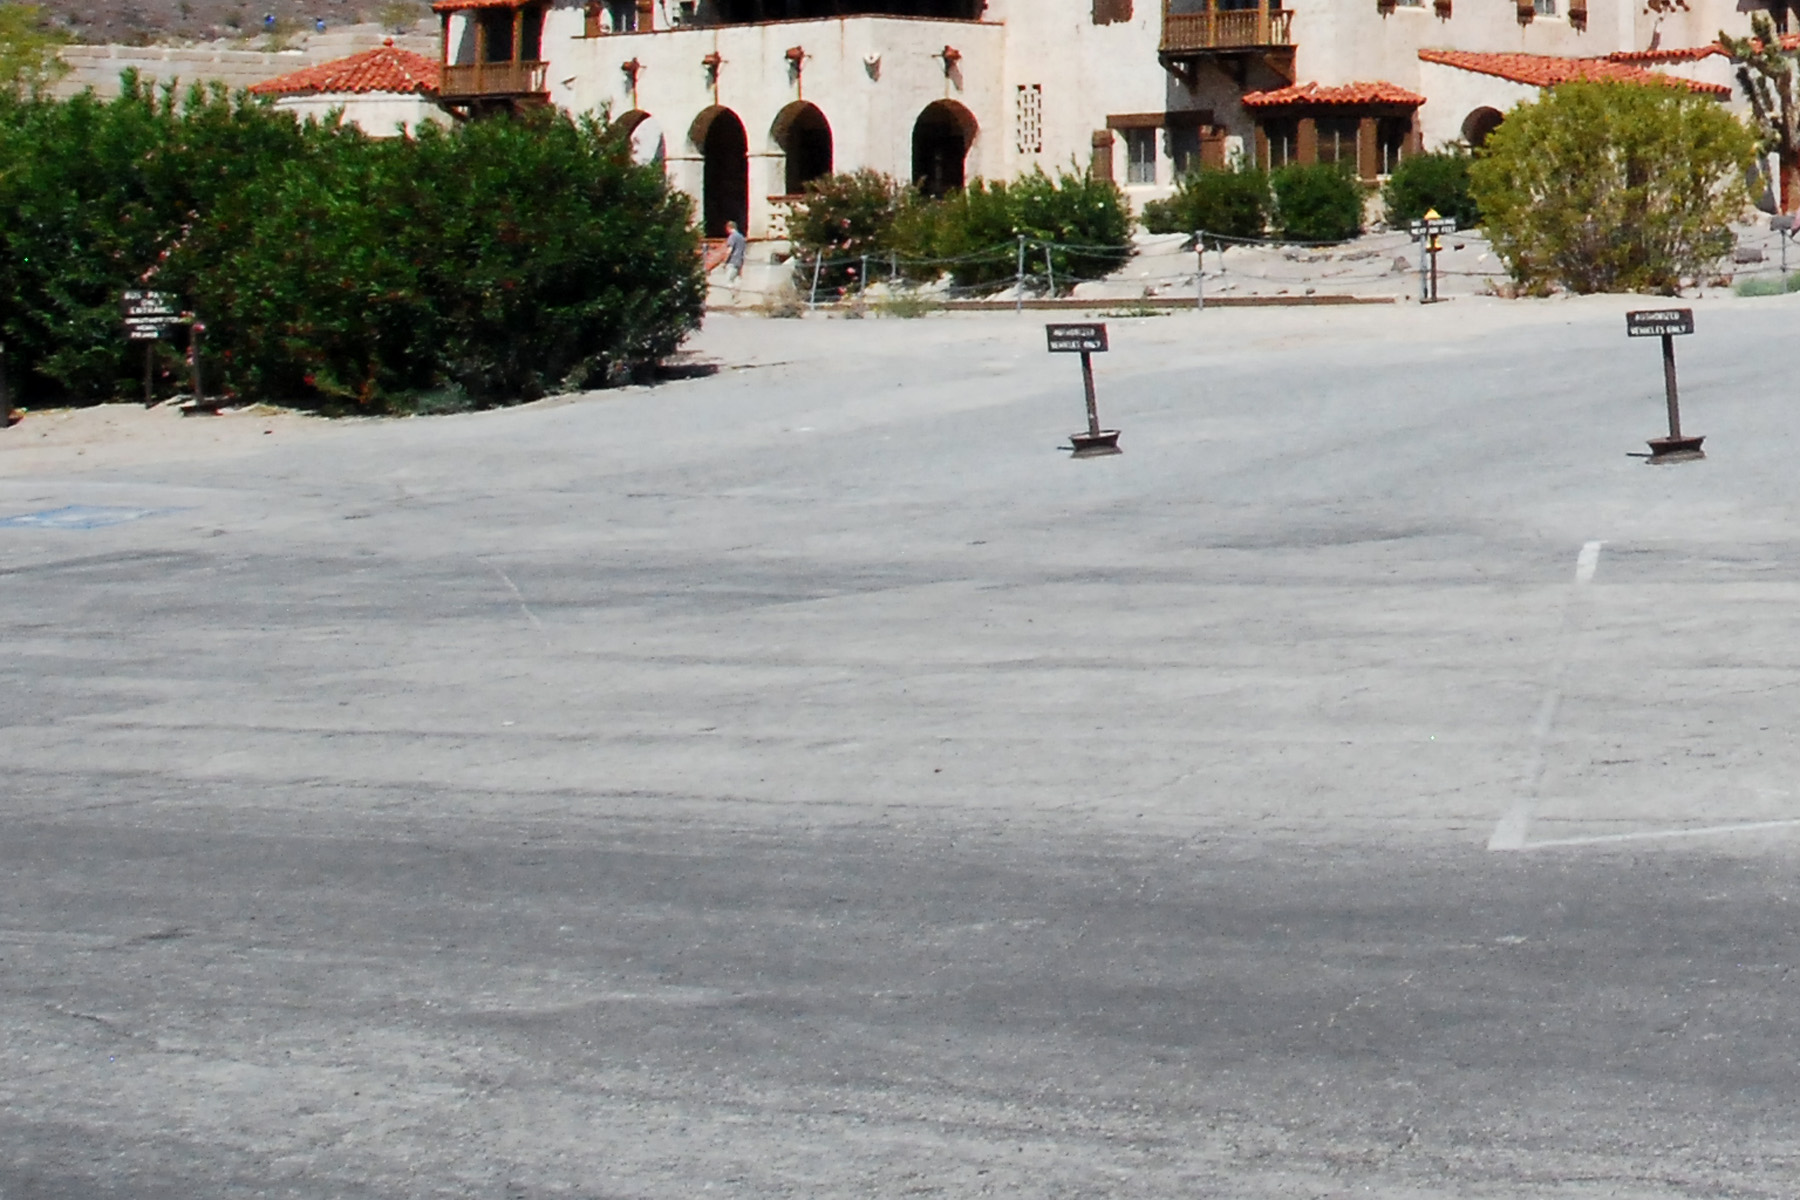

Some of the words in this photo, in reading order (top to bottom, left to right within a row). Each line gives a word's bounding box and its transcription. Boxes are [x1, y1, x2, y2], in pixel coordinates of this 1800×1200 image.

[1634, 311, 1680, 321] AUTHORIZED
[1630, 325, 1665, 335] VEHICLES
[1666, 324, 1687, 334] ONLY
